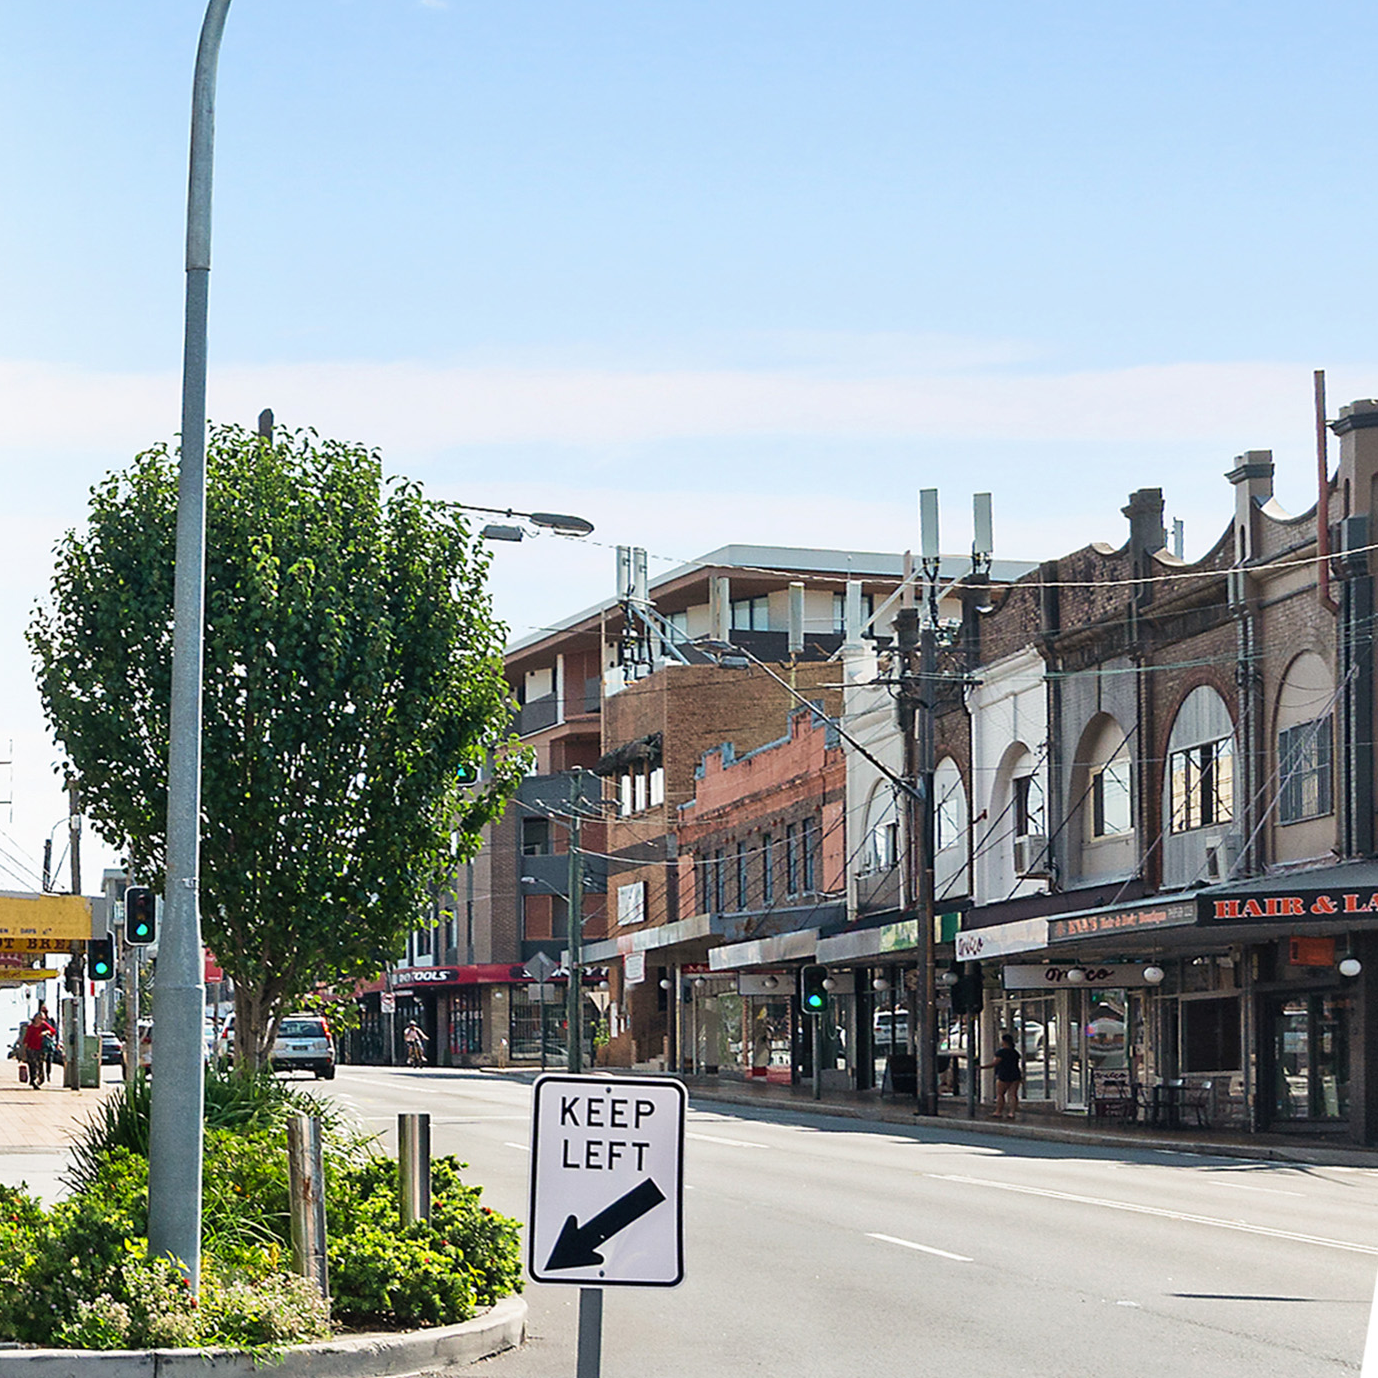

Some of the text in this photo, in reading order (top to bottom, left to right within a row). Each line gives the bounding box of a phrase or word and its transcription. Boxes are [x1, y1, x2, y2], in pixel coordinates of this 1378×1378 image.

[1213, 896, 1306, 919] HAIR
[1310, 895, 1338, 915] &
[560, 1096, 655, 1129] KEEP
[562, 1139, 650, 1171] LEFT
